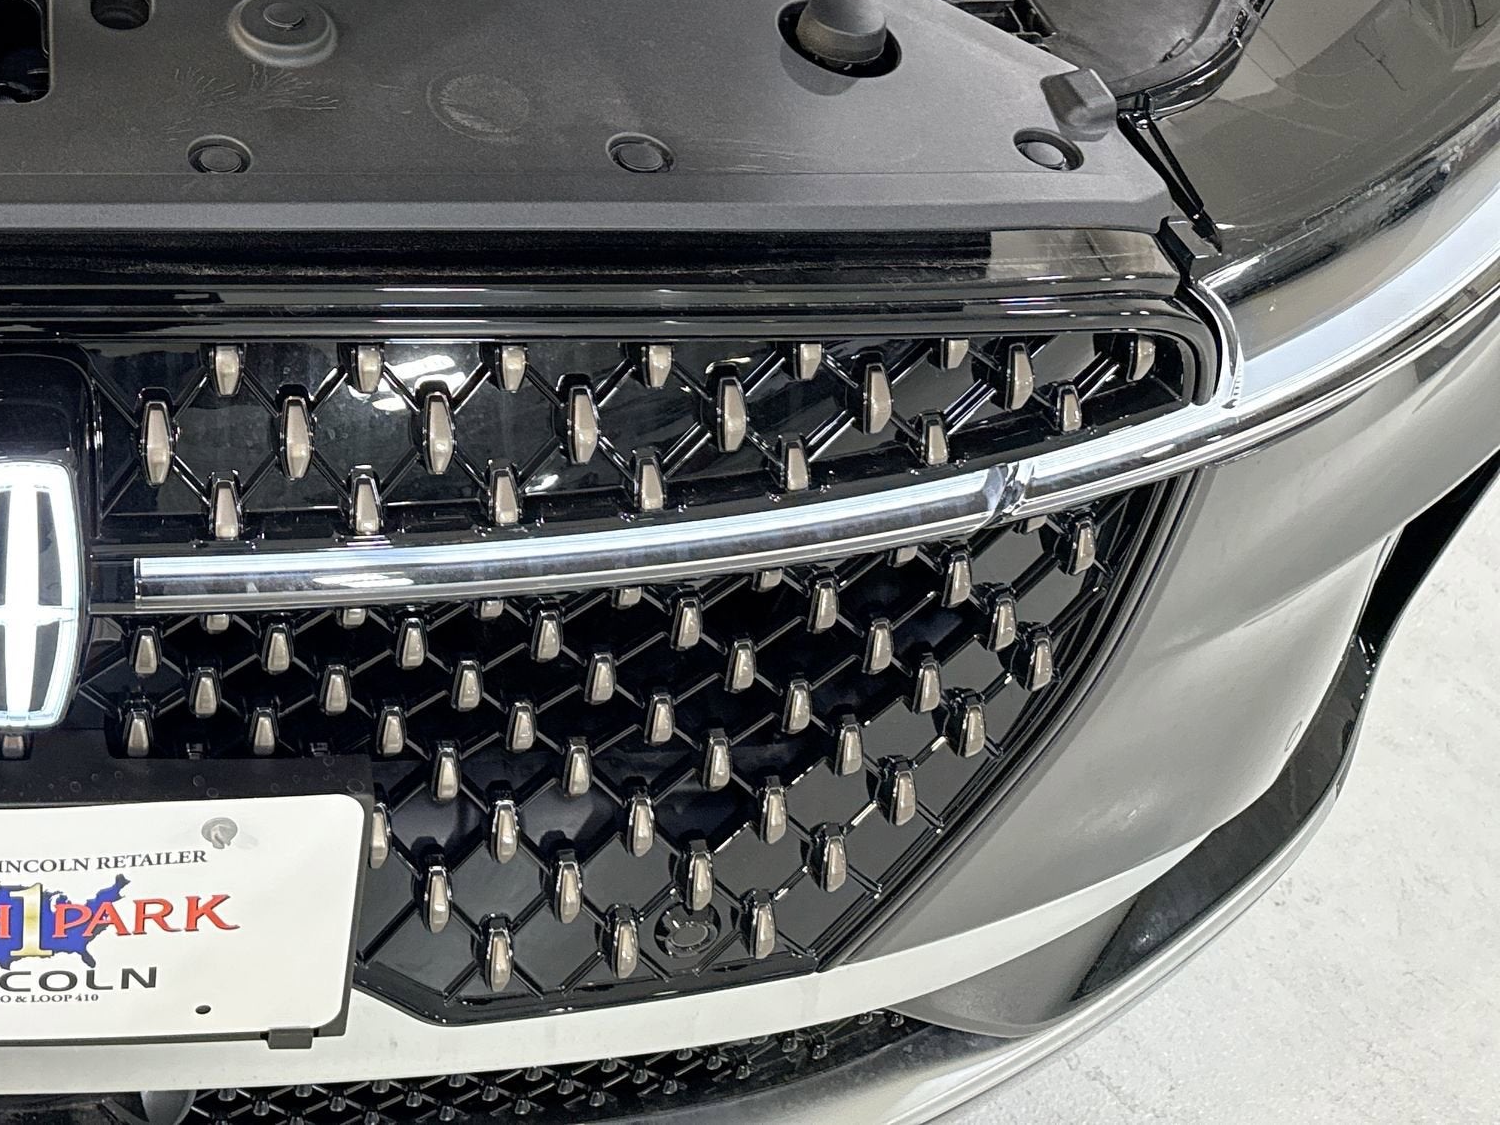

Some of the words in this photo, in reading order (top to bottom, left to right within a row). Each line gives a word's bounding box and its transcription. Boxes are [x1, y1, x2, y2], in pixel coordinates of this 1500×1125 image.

[96, 849, 208, 870] RETAILER
[52, 894, 239, 938] PARK
[15, 994, 28, 1003] &
[31, 994, 73, 1003] LOOP
[75, 992, 99, 1003] 410
